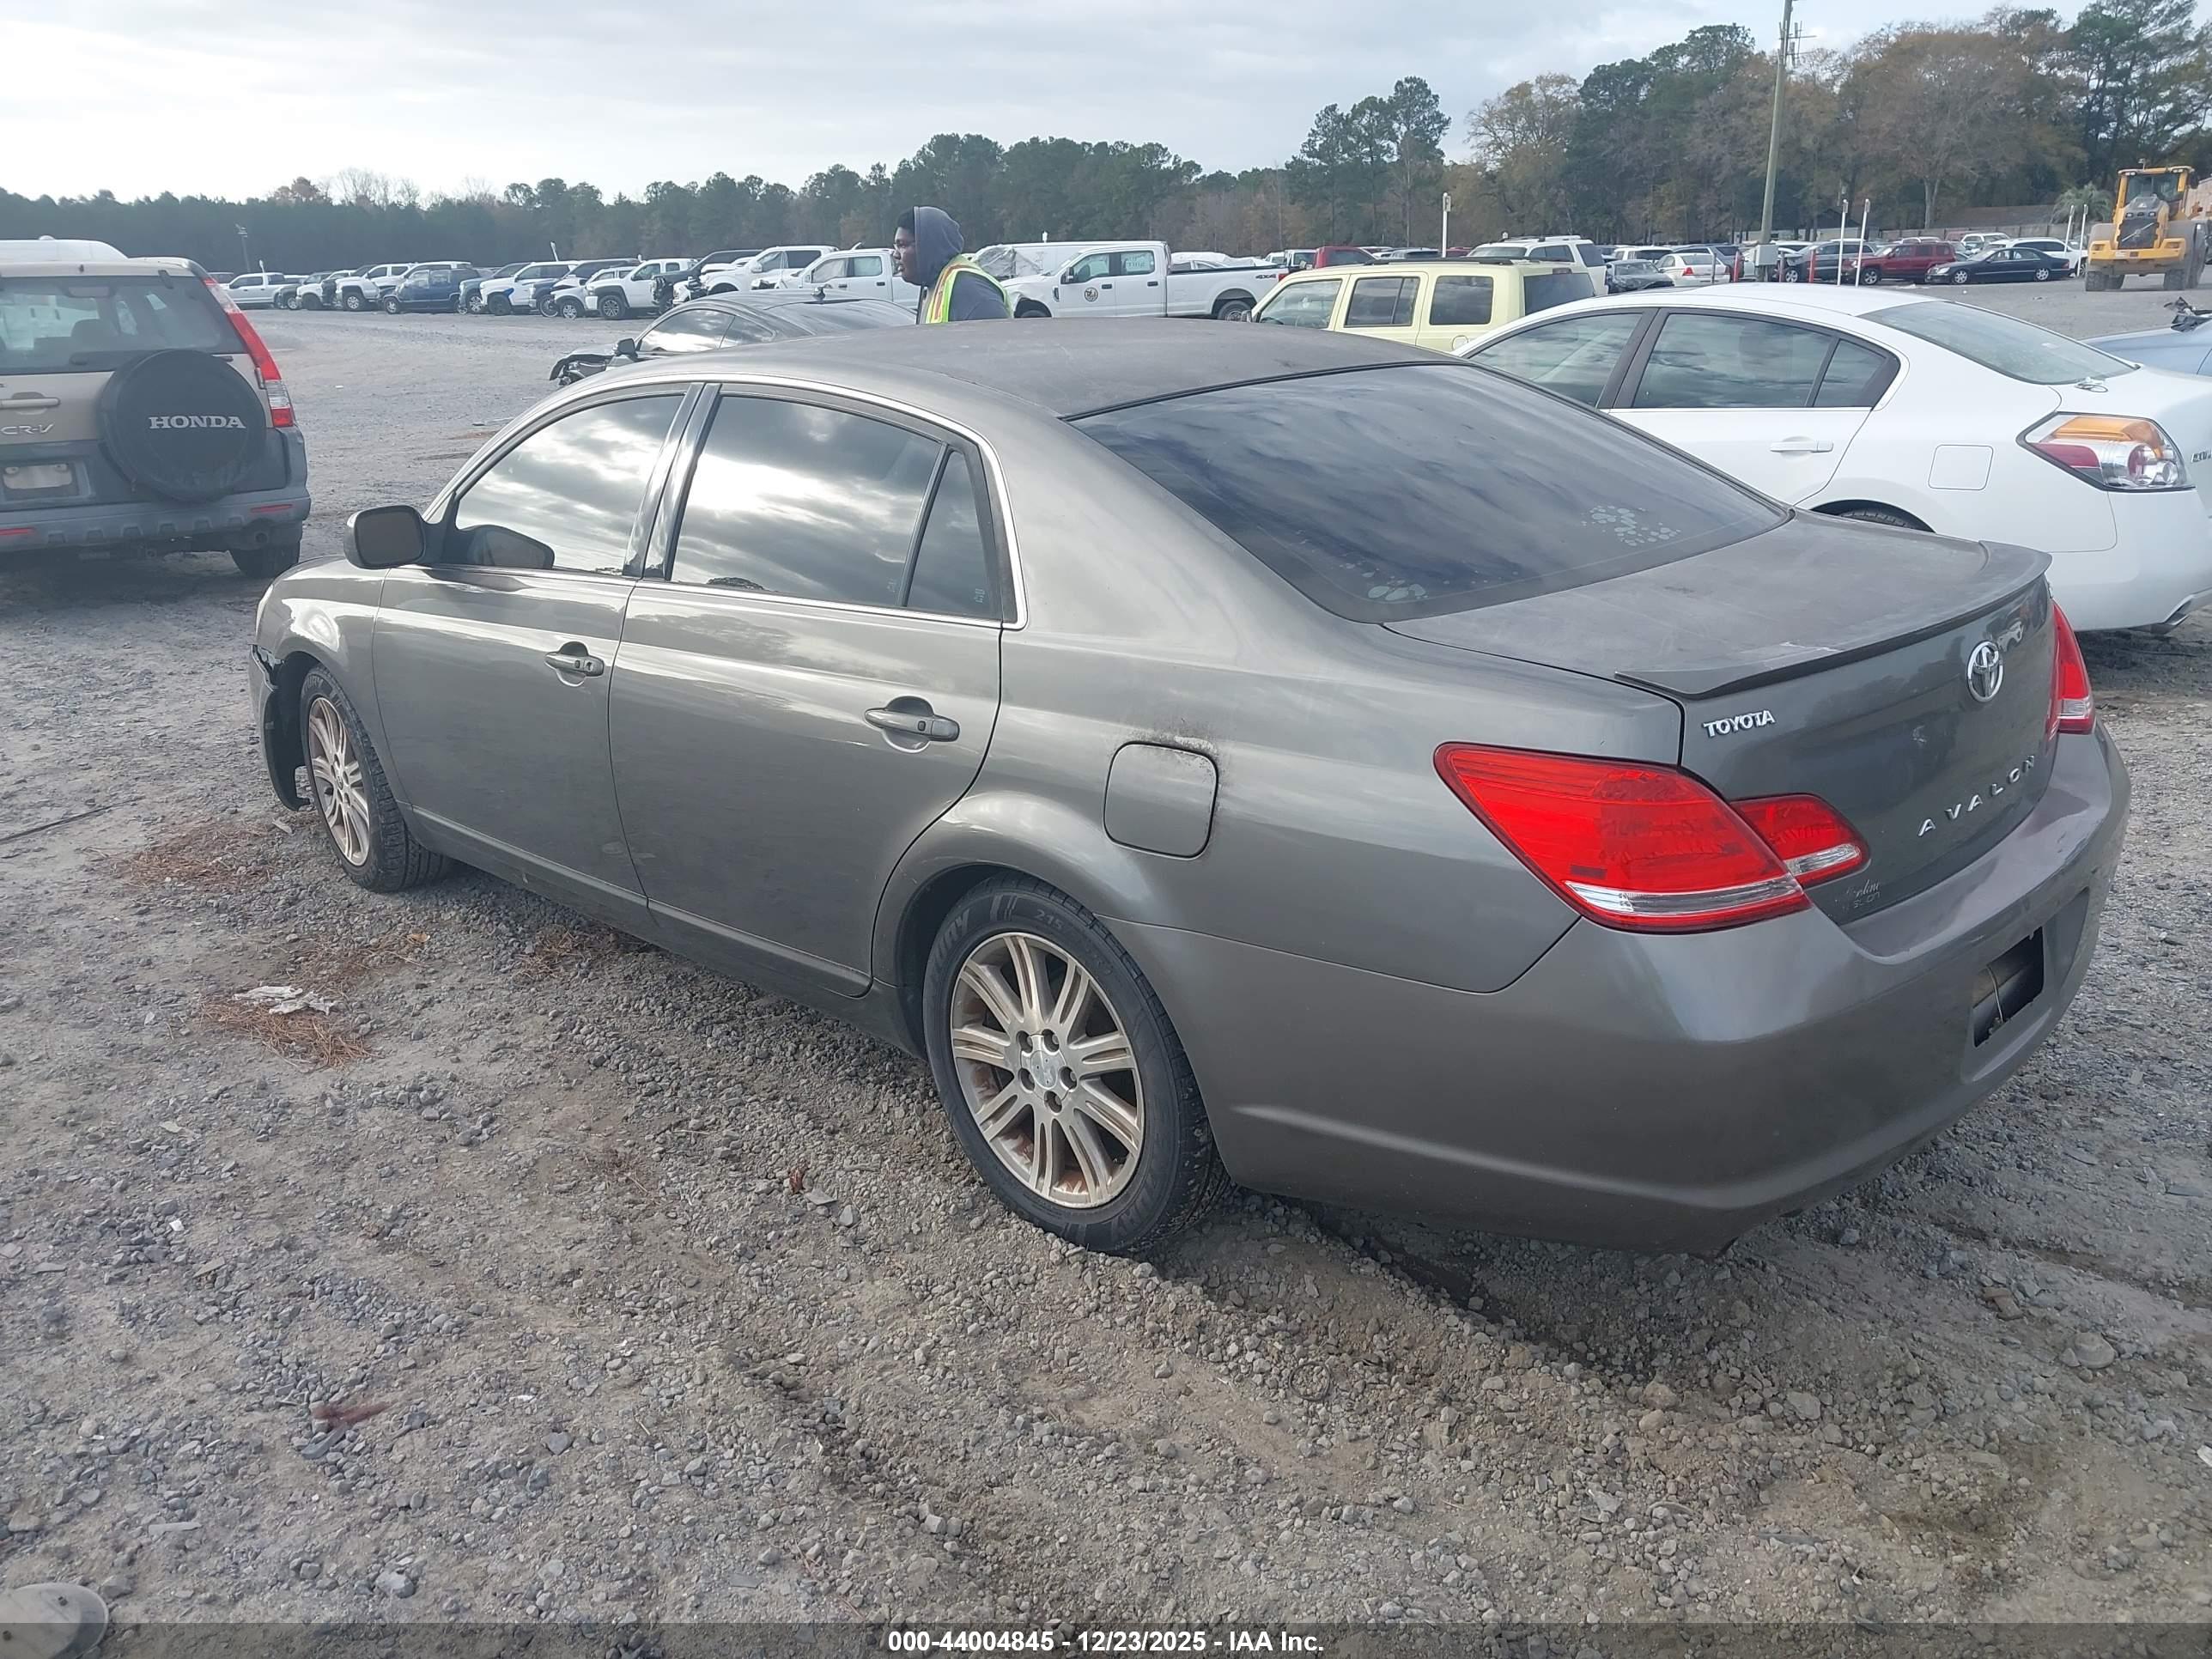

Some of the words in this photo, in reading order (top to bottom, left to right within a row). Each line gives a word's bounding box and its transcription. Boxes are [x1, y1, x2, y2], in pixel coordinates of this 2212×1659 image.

[0, 422, 55, 435] CR-V
[148, 415, 246, 429] HONDA
[1703, 709, 1776, 738] TOYOTA
[1917, 754, 2035, 837] AVALON
